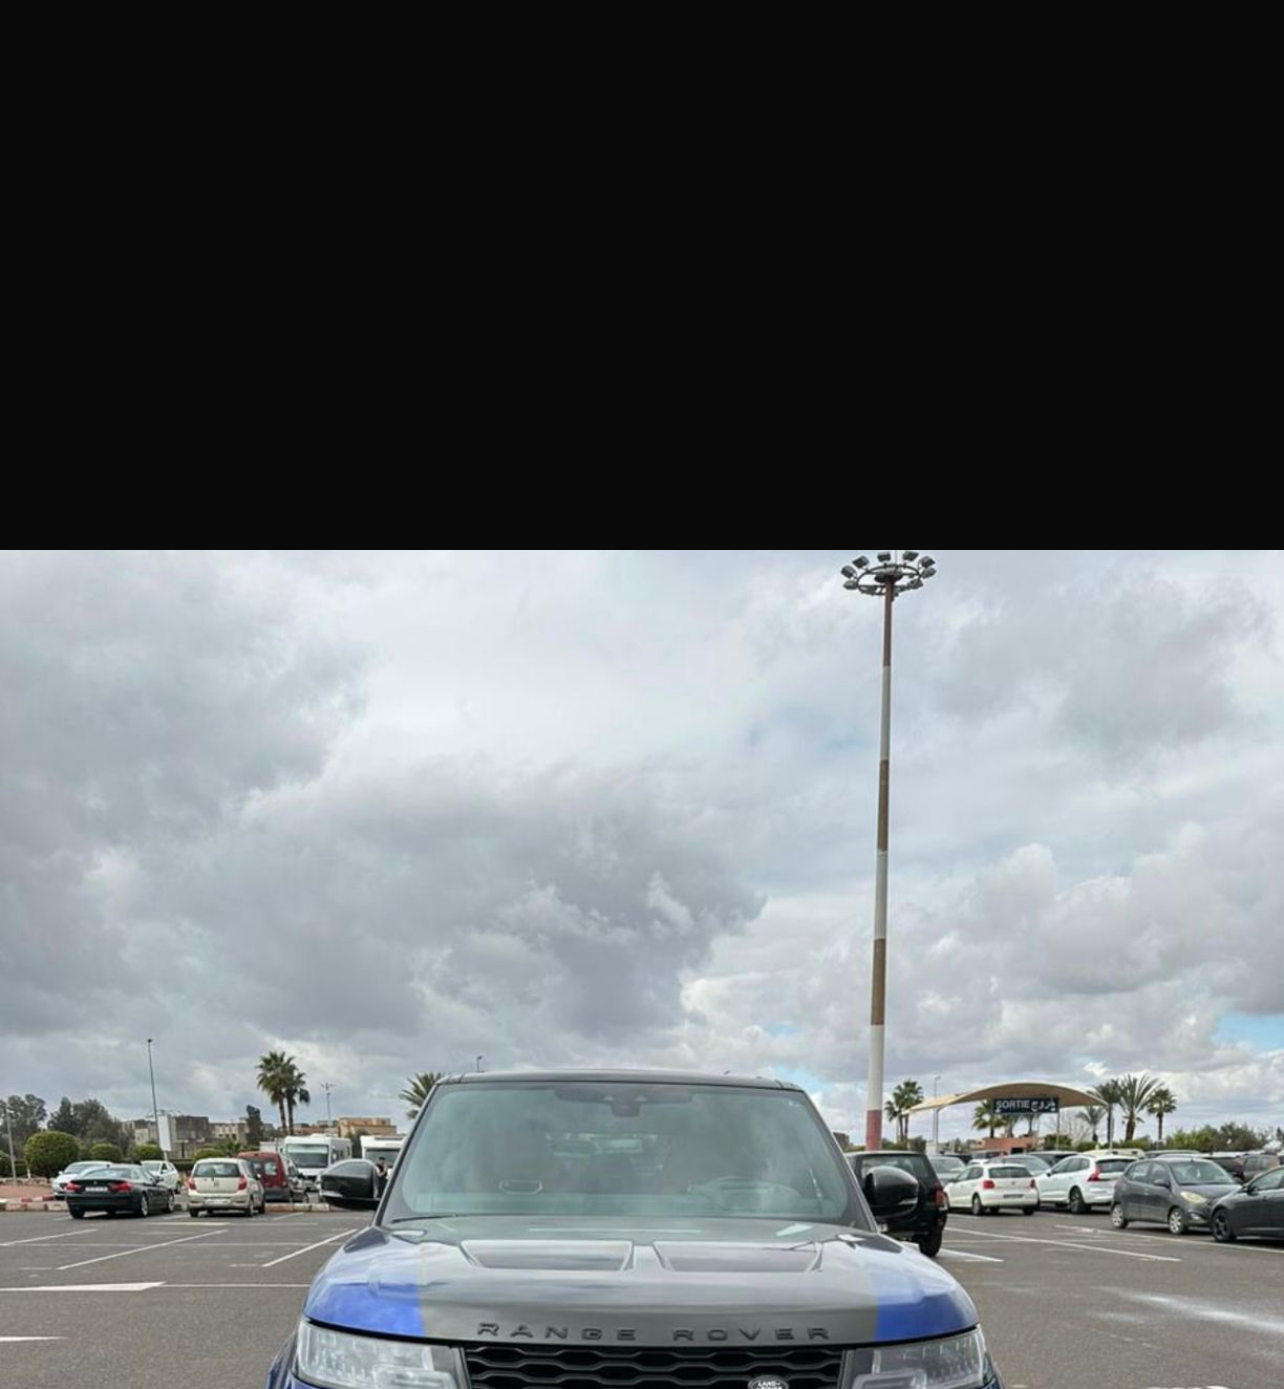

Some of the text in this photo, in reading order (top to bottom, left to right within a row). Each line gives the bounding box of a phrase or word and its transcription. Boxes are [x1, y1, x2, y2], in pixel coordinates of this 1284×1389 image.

[995, 1099, 1030, 1109] SORTIE
[1031, 1098, 1056, 1112] خروج
[477, 1322, 830, 1342] RANGE ROVER
